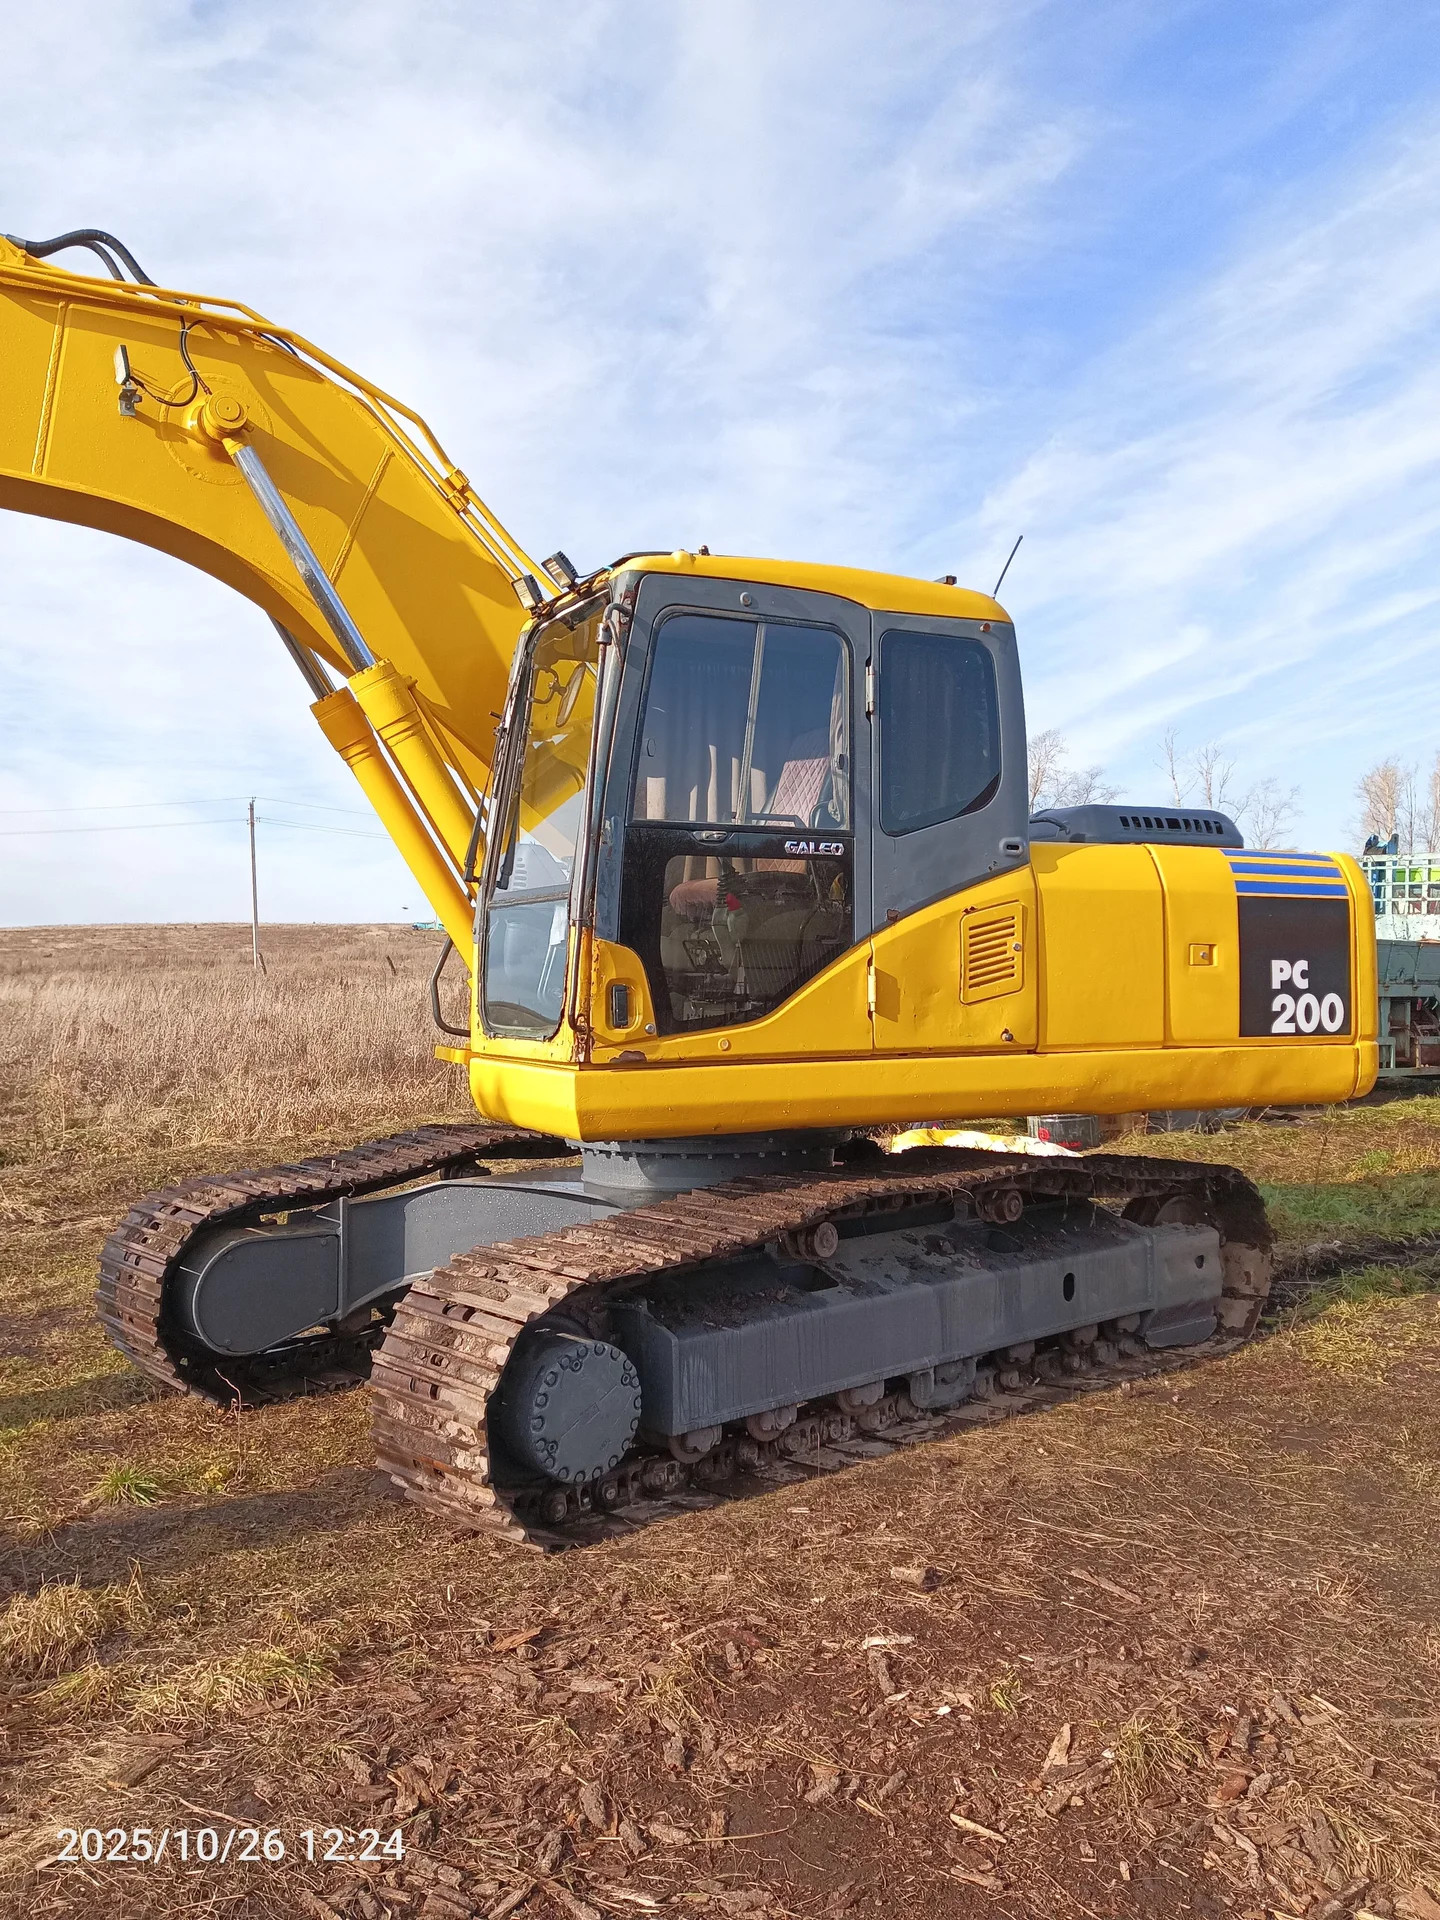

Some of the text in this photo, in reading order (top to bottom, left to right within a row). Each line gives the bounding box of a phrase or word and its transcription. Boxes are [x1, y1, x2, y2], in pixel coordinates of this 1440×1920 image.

[784, 840, 845, 856] GALEO
[1271, 959, 1309, 990] PC
[1271, 992, 1345, 1034] 200
